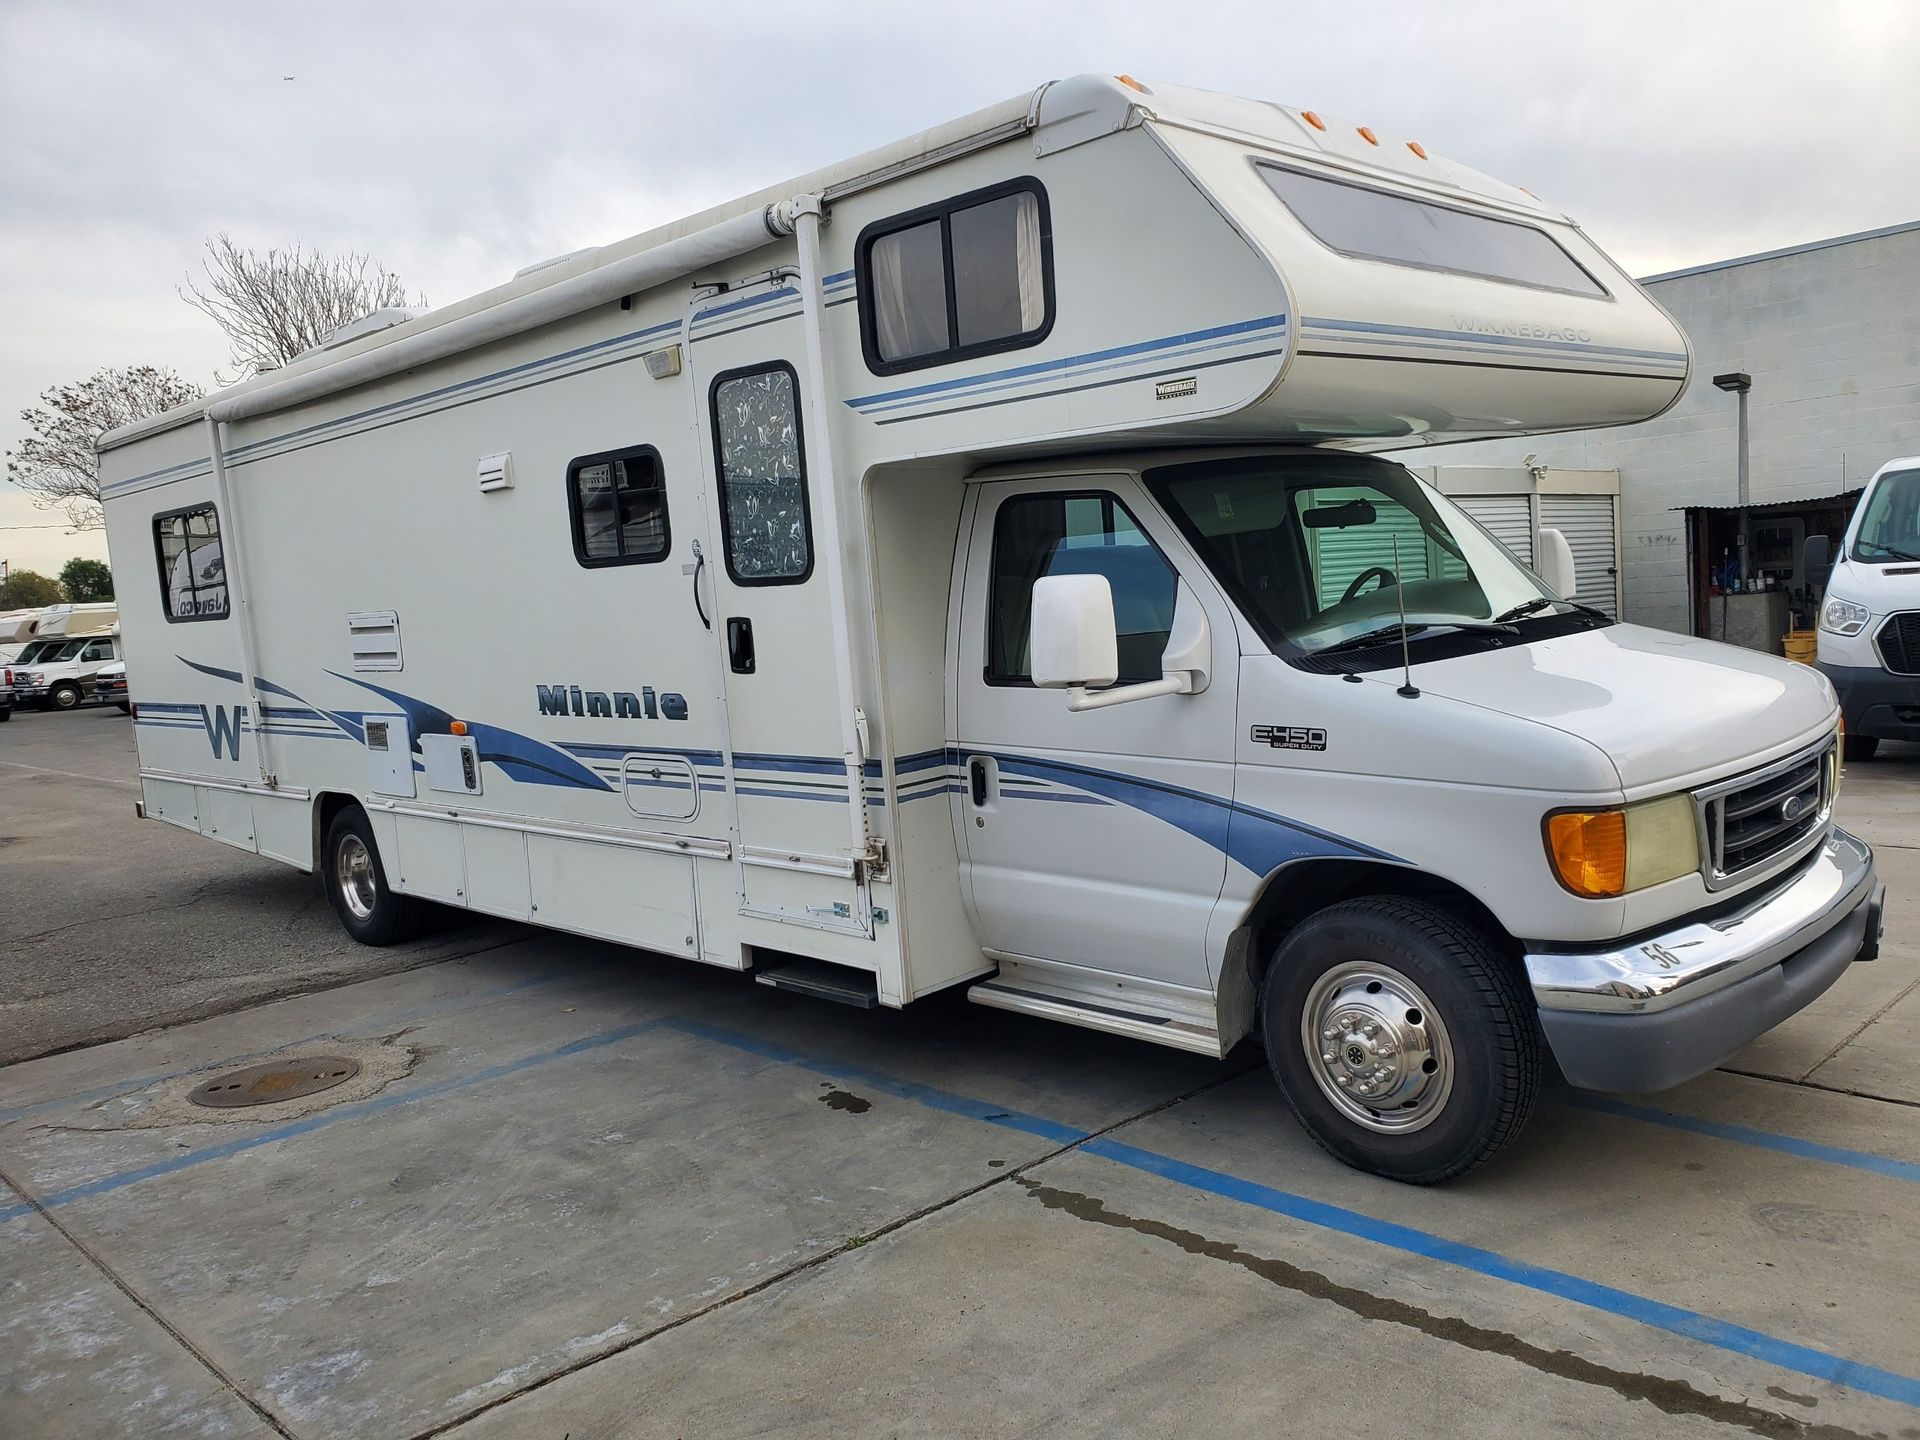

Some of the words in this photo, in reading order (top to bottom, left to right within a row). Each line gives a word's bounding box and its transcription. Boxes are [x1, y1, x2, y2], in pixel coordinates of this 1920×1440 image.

[1450, 311, 1592, 343] WINNEBAGO
[536, 685, 689, 721] Minnie
[199, 704, 242, 761] W
[1273, 741, 1300, 749] SUPER
[1640, 943, 1681, 969] 56
